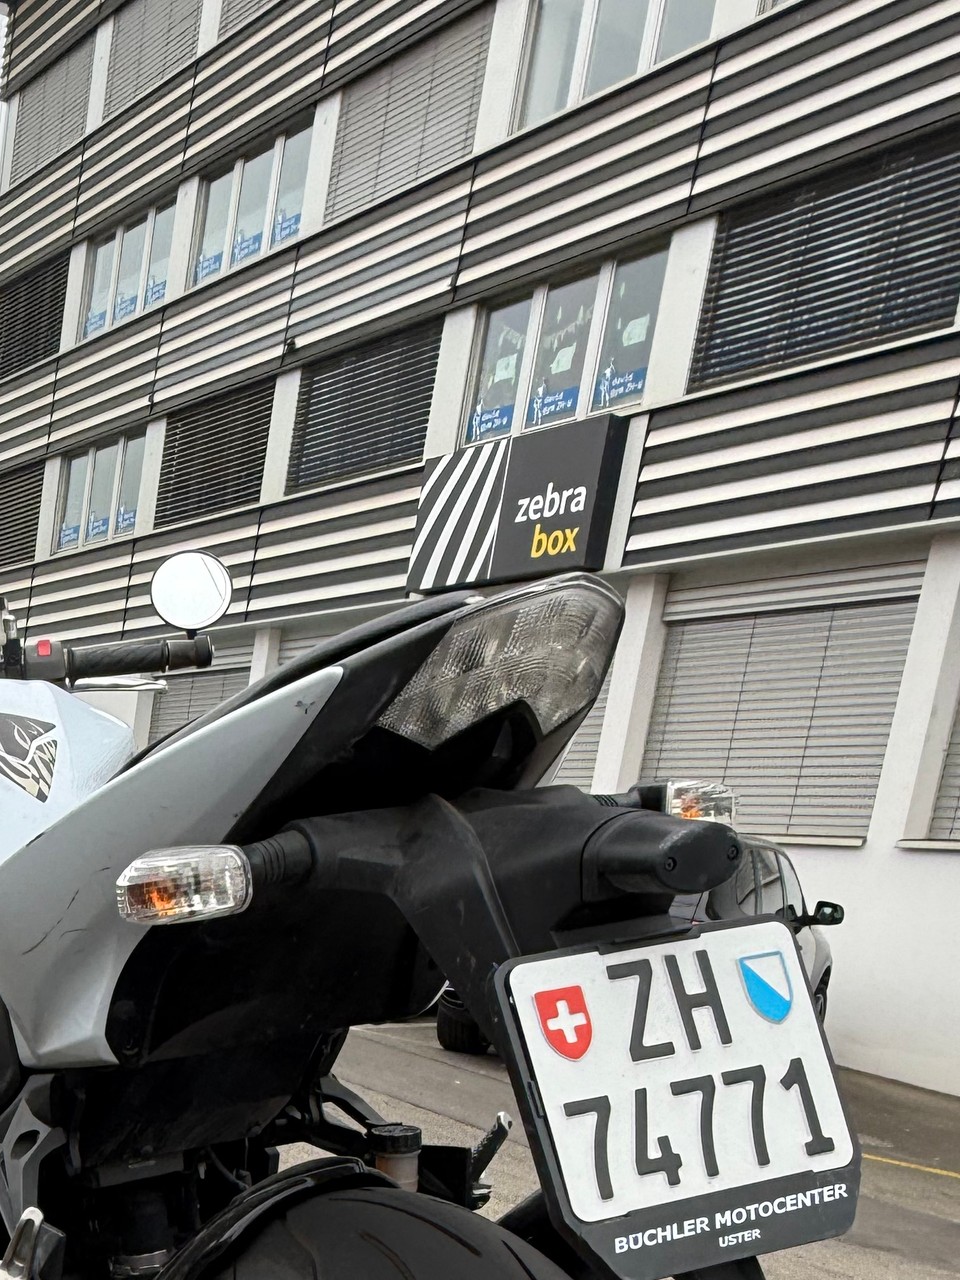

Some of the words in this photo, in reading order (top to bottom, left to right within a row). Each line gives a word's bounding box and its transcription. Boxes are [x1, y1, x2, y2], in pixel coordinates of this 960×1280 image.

[514, 482, 587, 523] zebra
[530, 523, 580, 558] box
[606, 949, 733, 1063] ZH
[563, 1057, 835, 1201] 74771
[614, 1216, 710, 1254] BÜCHLER
[715, 1183, 848, 1230] MOTOCENTER
[718, 1229, 761, 1248] USTER
